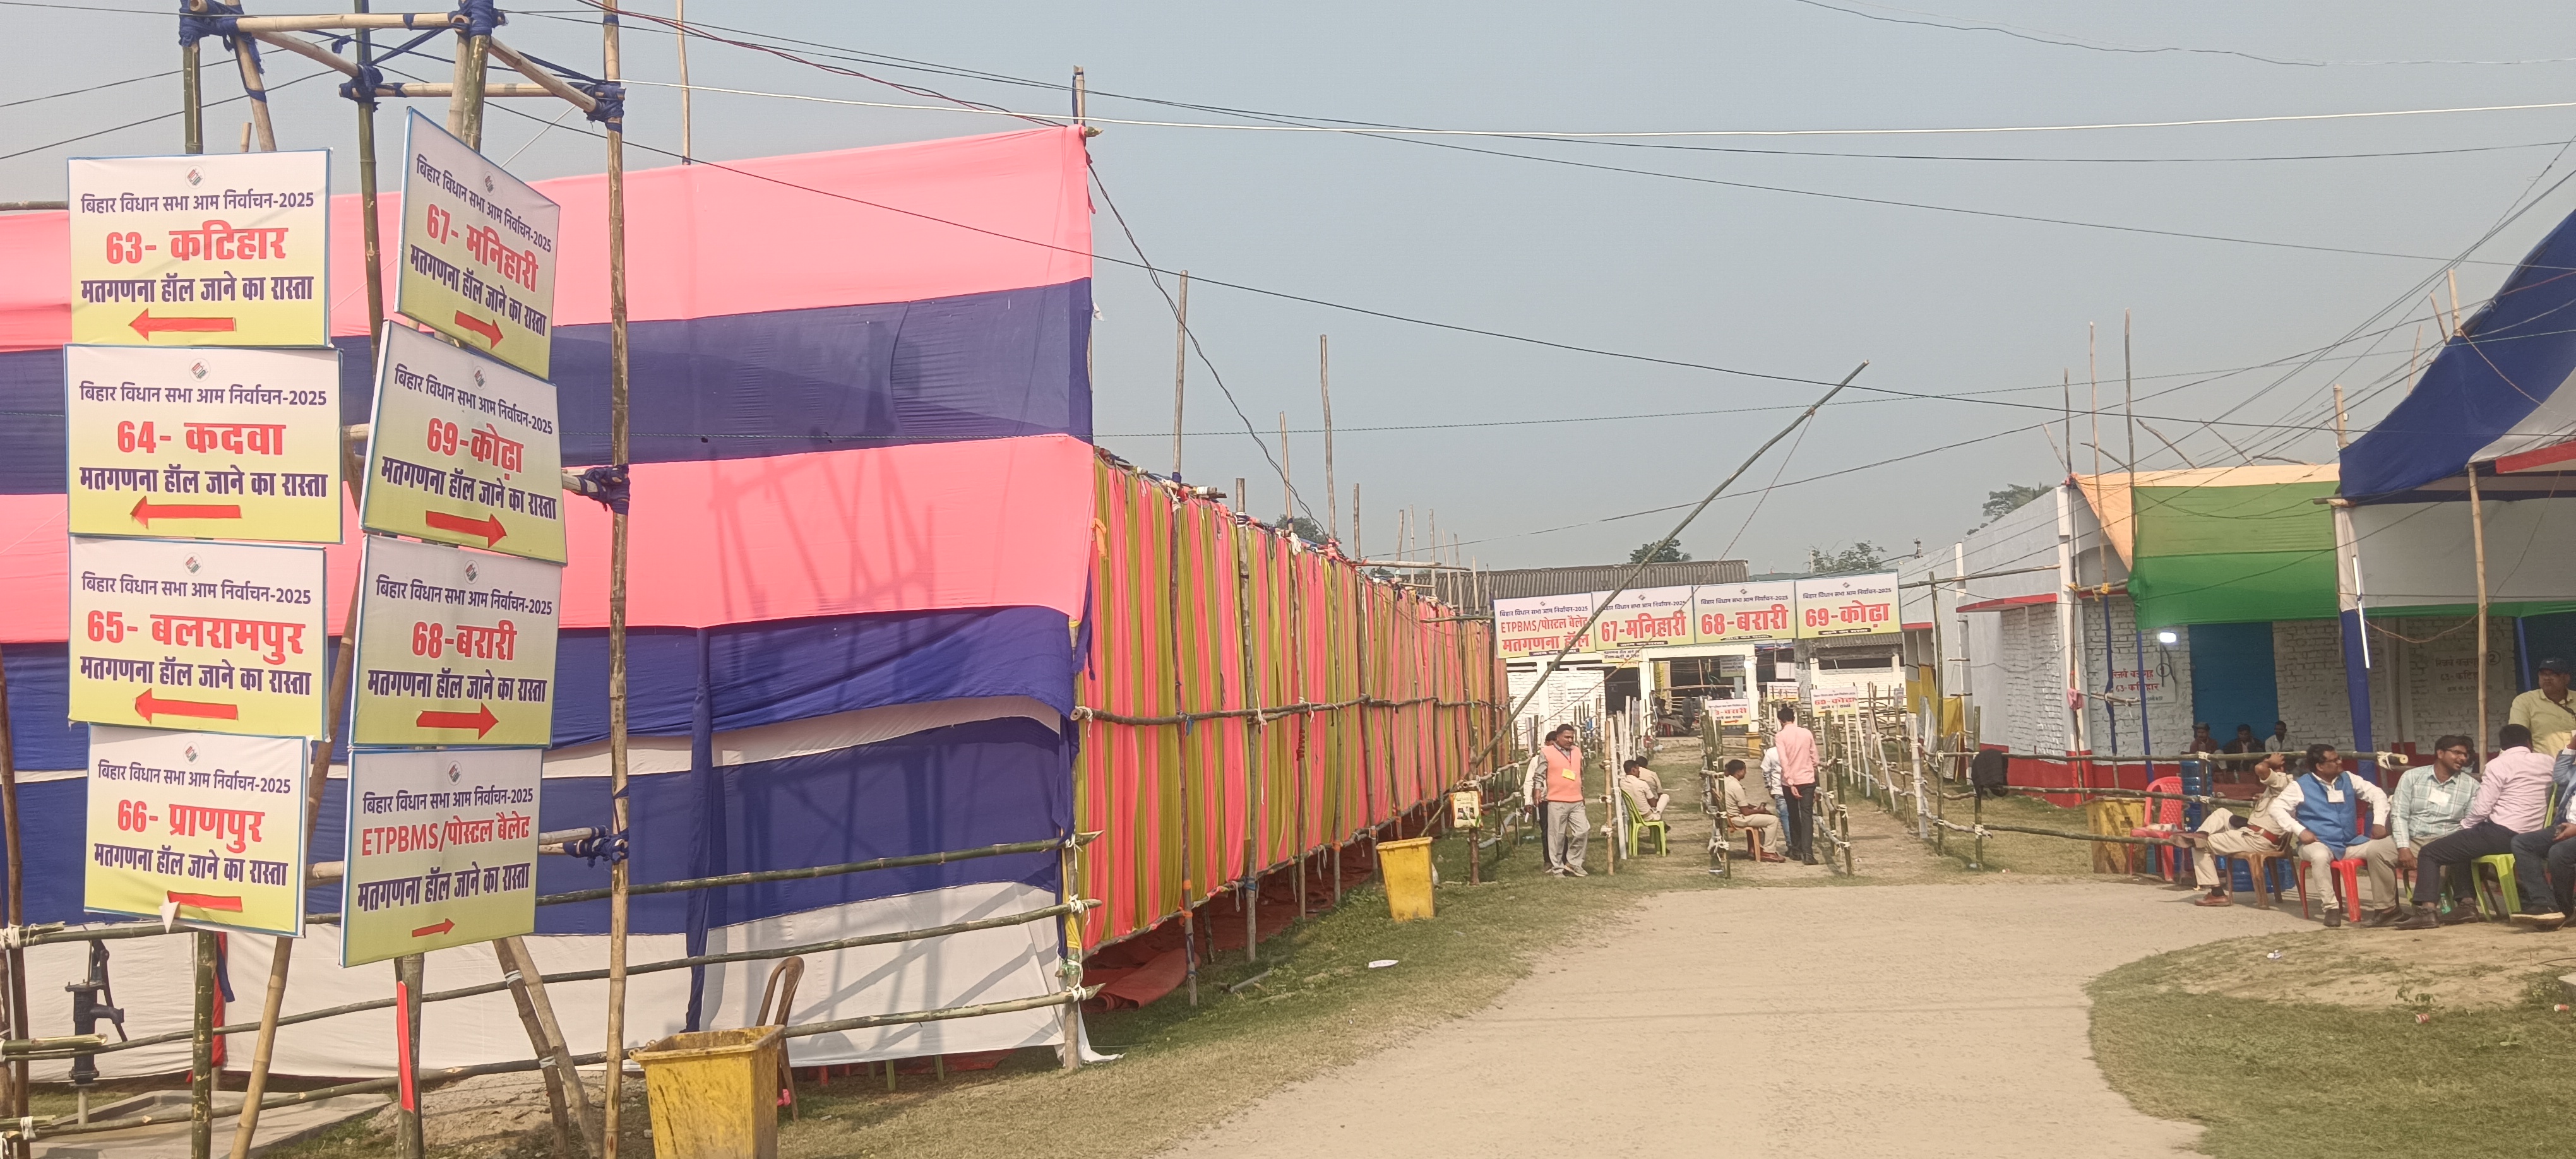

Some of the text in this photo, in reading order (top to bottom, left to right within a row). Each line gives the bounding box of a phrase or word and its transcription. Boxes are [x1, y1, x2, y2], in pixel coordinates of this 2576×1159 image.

[81, 188, 313, 213] बिहार विधान सभा आम निर्वाचन-2025
[417, 154, 551, 253] बिहार विधान सभा आम निर्वाचन-2025
[107, 220, 289, 264] 63- कटिहार
[427, 204, 539, 292] 67- मनिहारी
[81, 271, 314, 302] मतगणना हॉल जाने का रास्ता
[411, 244, 547, 336] मतगणना हॉल जाने का रास्ता
[80, 381, 326, 405] बिहार विधान सभा आम निर्वाचन-2025
[395, 364, 552, 434] बिहार विधान सभा आम निर्वाचन-2025
[118, 421, 286, 455] 64- कदवा
[427, 418, 523, 480] 69-कोढ़ा
[80, 464, 328, 497] मतगणना हॉल जाने का रास्ता
[381, 456, 556, 520] मतगणना हॉल जाने का रास्ता
[81, 571, 311, 604] बिहार विधान सभा आम निर्वाचन-2025
[376, 574, 552, 615] बिहार विधान सभा आम निर्वाचन-2025
[1501, 615, 1588, 633] ETPBMS/पोस्टल बैलेट
[1601, 610, 1686, 641] 67-मनिहारी
[1702, 604, 1788, 634] 68-बरारी
[1806, 600, 1890, 627] 69-कोढ़ा
[88, 610, 306, 665] 65- बलरामपुर
[412, 620, 517, 660] 68-बरारी
[1502, 636, 1559, 651] मतगणना
[80, 657, 311, 695] मतगणना हॉल जाने का रास्ता
[2489, 653, 2496, 663] 2
[368, 667, 547, 702] मतगणना हॉल जाने का रास्ता
[98, 759, 290, 793] बिहार विधान सभा आम निर्वाचन-2025
[363, 785, 533, 814] बिहार विधान सभा आम निर्वाचन-2025
[118, 800, 265, 853] 66- प्राणपुर
[362, 811, 530, 855] ETPBMS/पोस्टल बैलेट
[94, 843, 288, 886] मतगणना हॉल जाने का रास्ता
[358, 862, 530, 912] मतगणना हॉल जाने का रास्ता
